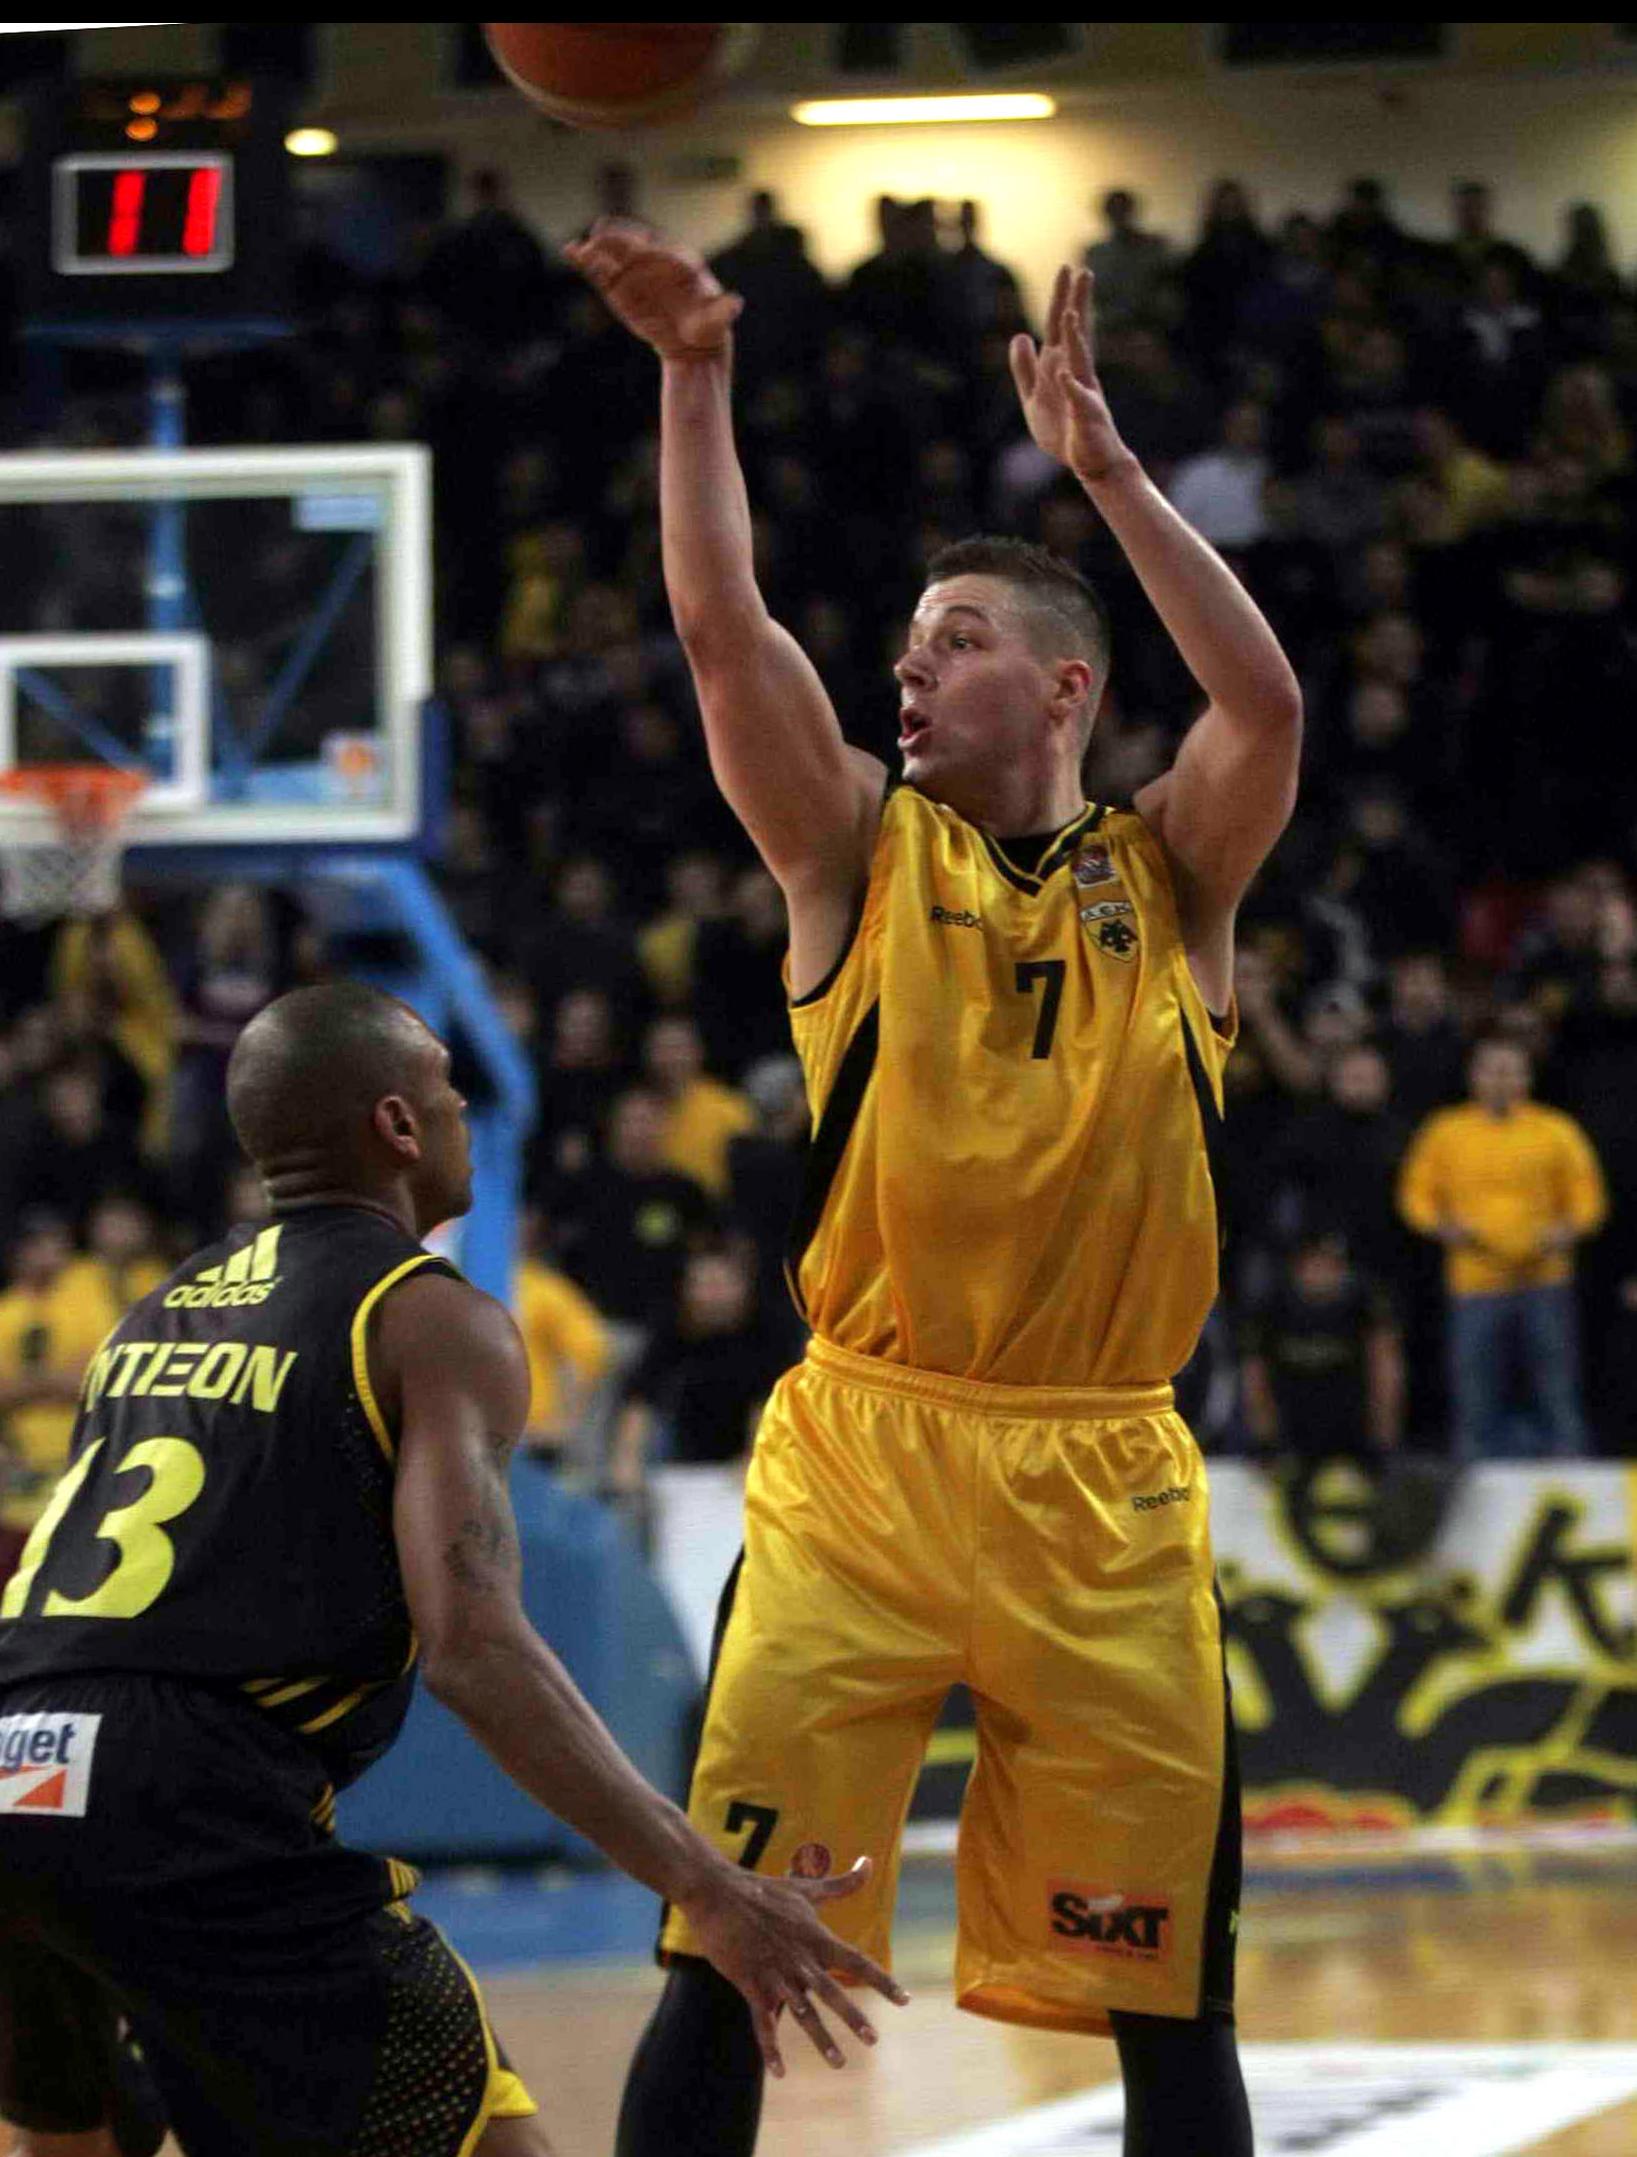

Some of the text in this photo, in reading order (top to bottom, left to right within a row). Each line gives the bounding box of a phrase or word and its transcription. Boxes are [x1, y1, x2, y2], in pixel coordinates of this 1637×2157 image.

[108, 167, 222, 259] 11
[931, 905, 985, 931] Reebo
[1014, 959, 1067, 1060] 7
[162, 1278, 281, 1309] adidas
[0, 1436, 206, 1620] 13
[1131, 1486, 1191, 1512] Reebo
[0, 1722, 77, 1773] get
[724, 1801, 780, 1871] 7
